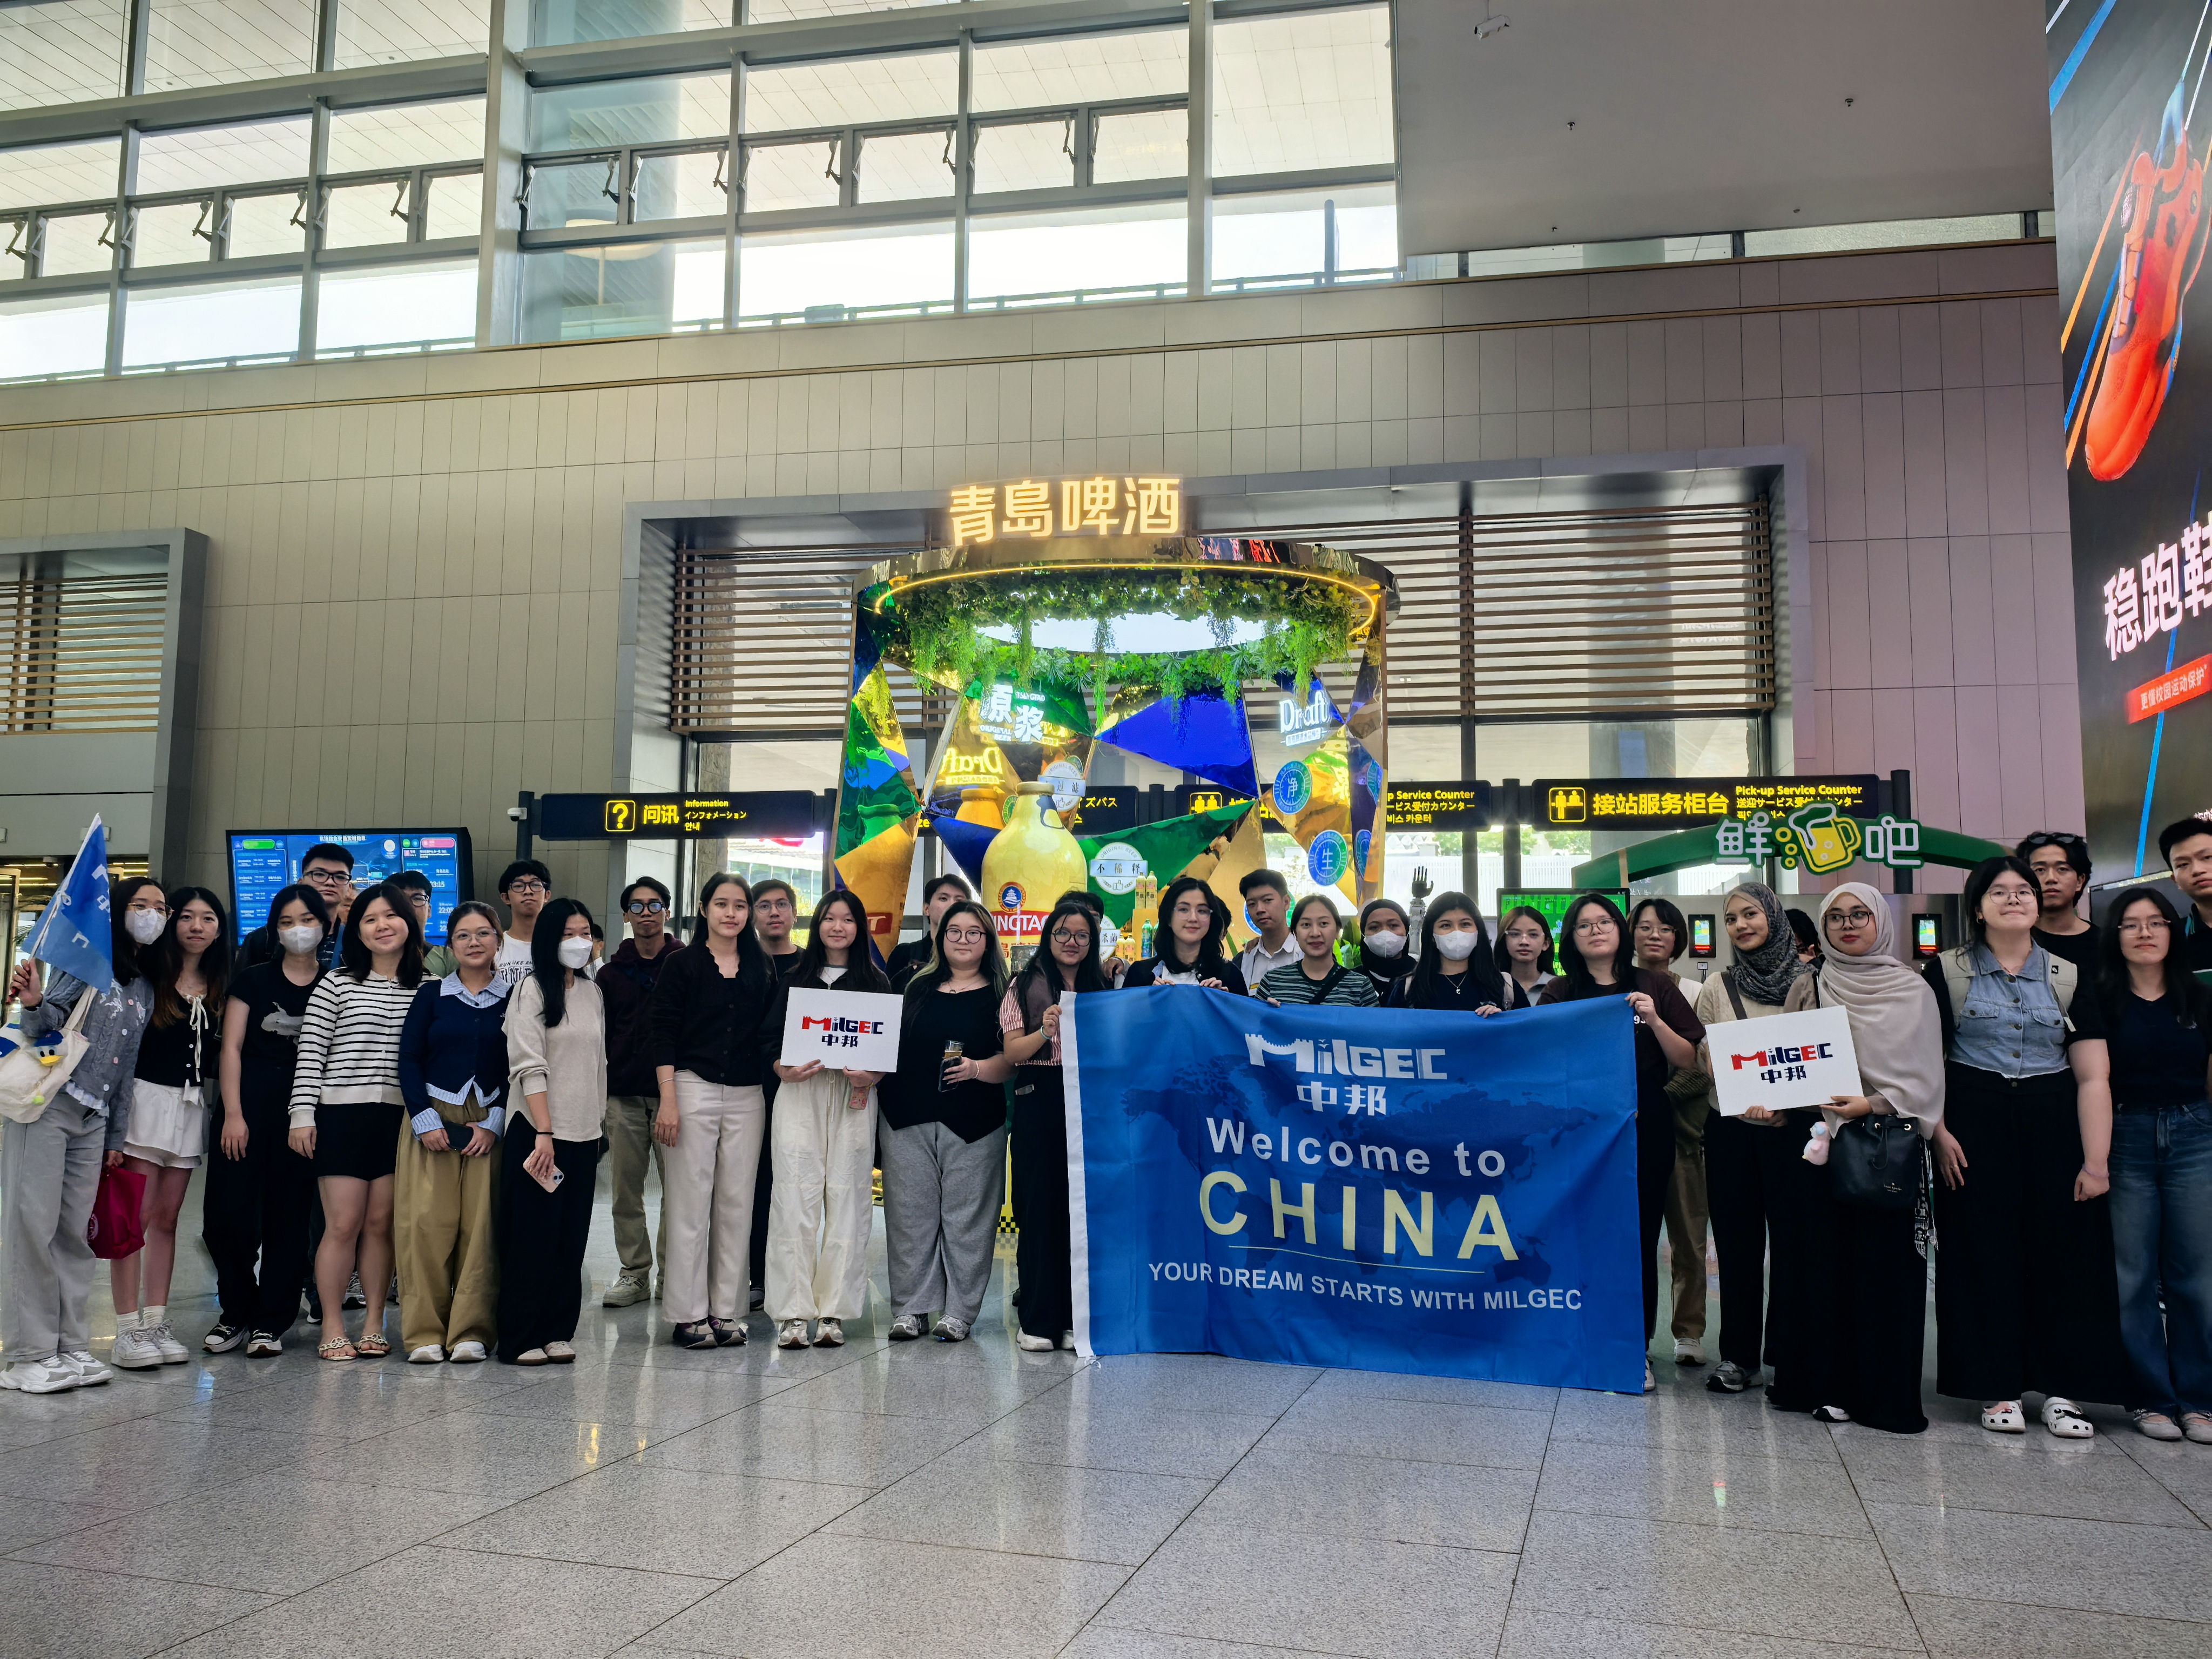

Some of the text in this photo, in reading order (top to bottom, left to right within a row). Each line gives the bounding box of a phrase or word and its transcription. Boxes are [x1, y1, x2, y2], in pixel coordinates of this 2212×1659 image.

[949, 476, 1180, 546] 青島啤酒
[2103, 521, 2212, 661] 稳跑鞋
[1279, 691, 1328, 733] Draft
[1396, 790, 1432, 800] Service
[1434, 790, 1475, 800] Counter
[1735, 784, 1863, 798] Pick-up Service Counter
[685, 799, 729, 808] Information
[1386, 801, 1475, 812] ービス受付カウンター
[1593, 791, 1730, 815] 接站服务柜台
[643, 804, 679, 825] 问讯
[685, 811, 747, 820] インフォメーション
[1387, 813, 1432, 824] 비스 카운터
[685, 821, 700, 832] 안내
[1865, 815, 1921, 865] 吧
[1100, 846, 1137, 859] ORIGINAL BEER
[1321, 847, 1333, 870] 生
[821, 1034, 859, 1048] 中邦
[1761, 1064, 1807, 1084] 中邦
[1297, 1081, 1387, 1116] 中邦
[1206, 1117, 1506, 1177] Welcome to
[1199, 1170, 1520, 1260] CHINA
[1148, 1262, 1582, 1310] YOUR DREAM STARTS WITH MILGEC
